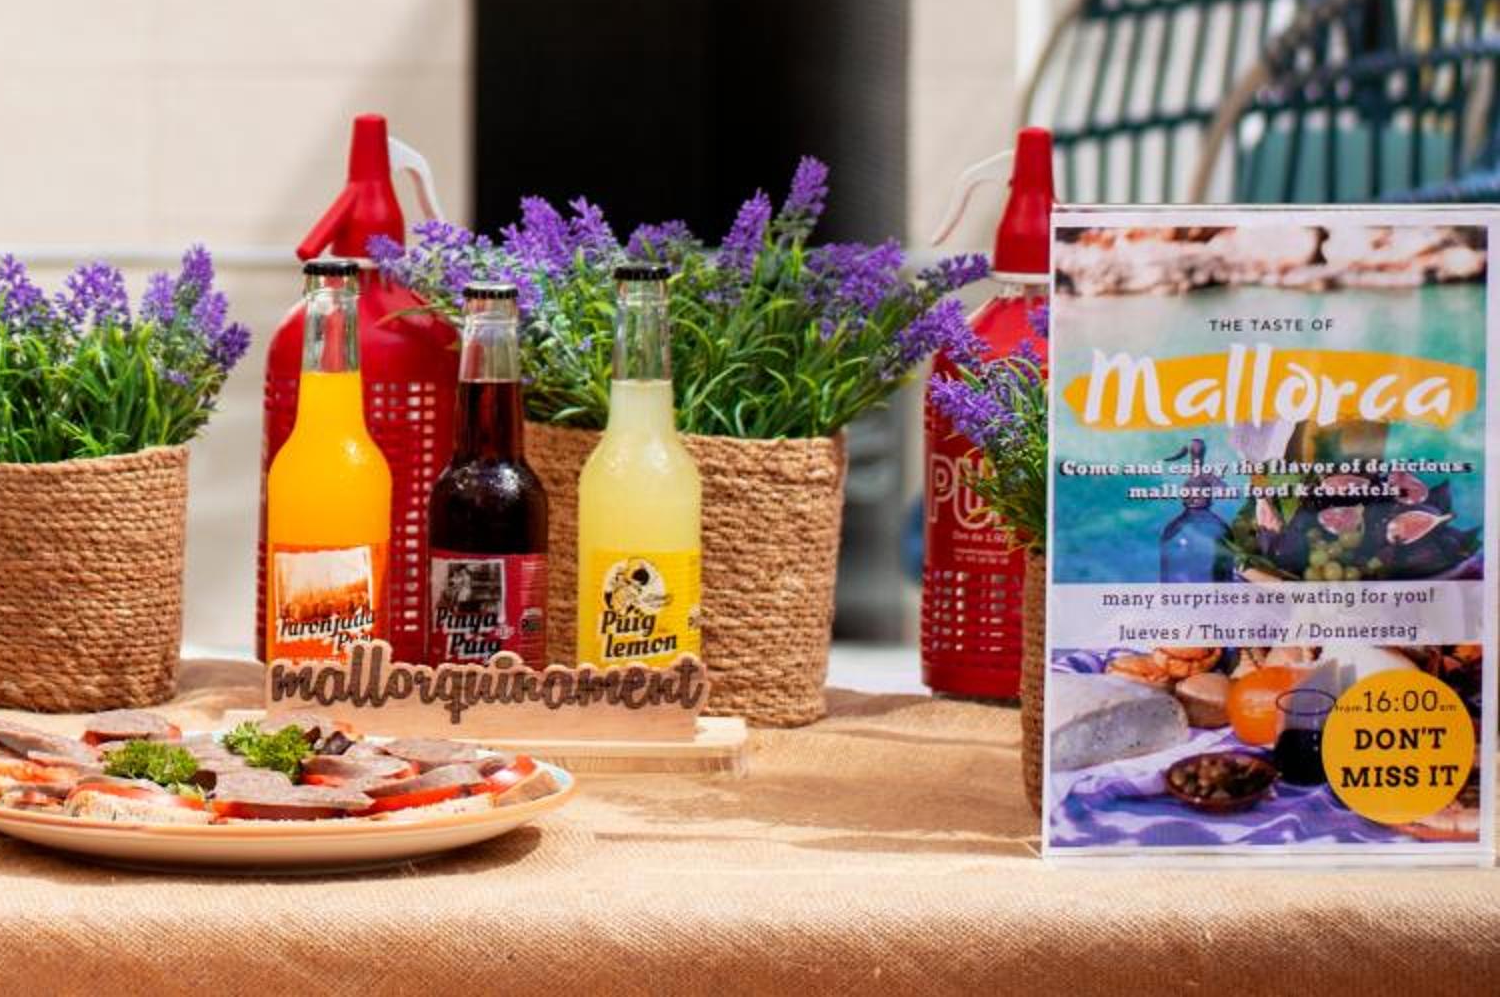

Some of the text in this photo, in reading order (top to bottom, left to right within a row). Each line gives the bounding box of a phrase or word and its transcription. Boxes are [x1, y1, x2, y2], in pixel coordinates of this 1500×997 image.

[1209, 318, 1334, 332] THE TASTE OF
[1083, 342, 1453, 428] Mallorca
[1061, 458, 1466, 478] Come and enjoy the flavor of delicious
[1129, 483, 1239, 499] mallorcan
[1243, 483, 1289, 498] food
[1294, 482, 1309, 497] &
[1102, 587, 1435, 610] many surprises are wating for you!
[436, 607, 498, 634] Pinya
[601, 609, 657, 638] Puig
[1119, 625, 1181, 641] Jueves
[1198, 623, 1289, 642] Thursday
[1309, 624, 1417, 641] Donnerstag
[605, 634, 677, 658] lemon
[271, 644, 704, 725] mallorquinament
[1364, 690, 1438, 713] 16:00
[1354, 726, 1447, 750] DON'T
[1341, 764, 1459, 788] MISS IT
